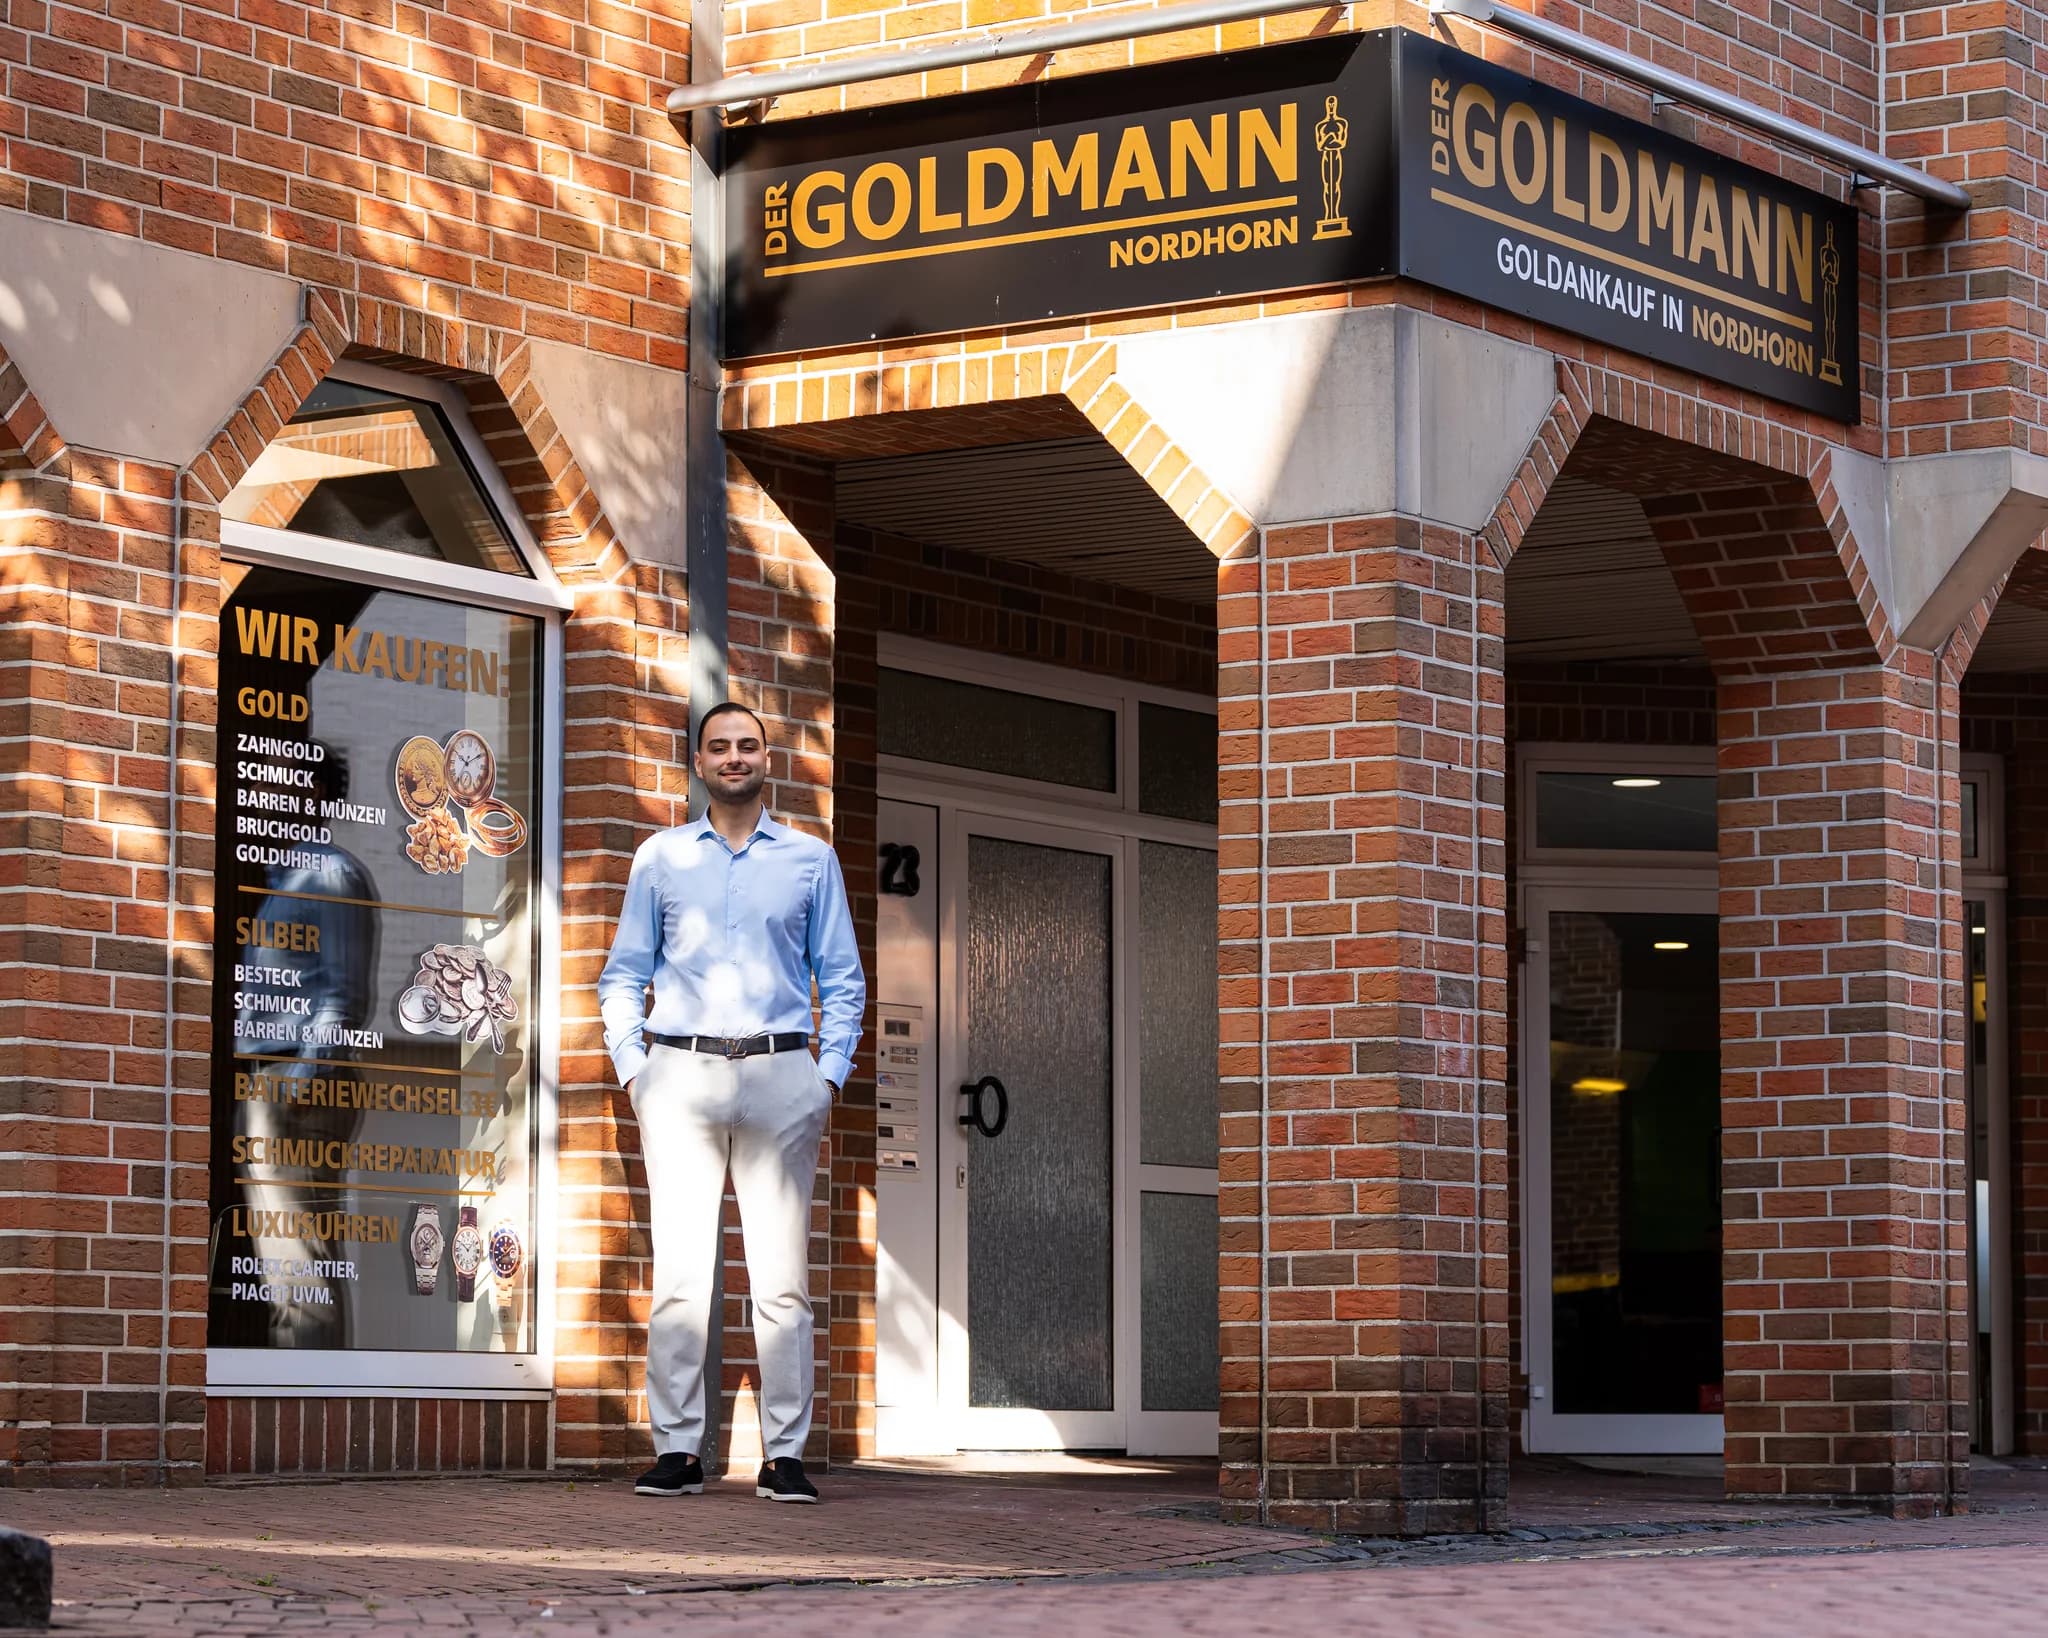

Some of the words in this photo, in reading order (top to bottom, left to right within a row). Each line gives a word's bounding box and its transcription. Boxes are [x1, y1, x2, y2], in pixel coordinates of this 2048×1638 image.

[1431, 77, 1450, 175] DER
[792, 102, 1298, 249] GOLDMANN
[1452, 82, 1813, 304] GOLDMANN
[764, 180, 788, 256] DER
[1110, 216, 1298, 268] NORDHORN
[1497, 237, 1656, 321] GOLDANKAUF
[1662, 294, 1683, 333] IN
[1692, 304, 1813, 376] NORDHORN
[235, 606, 319, 666] WIR
[334, 624, 511, 699] KAUFEN:
[237, 687, 309, 722] GOLD
[237, 733, 325, 762] ZAHNGOLD
[237, 761, 314, 789] SCHMUCK
[237, 789, 300, 815] BARREN
[305, 799, 316, 816] &
[320, 798, 386, 826] MÜNZEN
[237, 816, 332, 845] BRUCHGOLD
[236, 844, 332, 873] GOLDUHREN
[236, 917, 321, 953] SILBER
[234, 964, 302, 988] BESTECK
[234, 992, 311, 1016] SCHMUCK
[234, 1019, 297, 1042] BARREN
[302, 1026, 316, 1043] &
[317, 1024, 384, 1049] MÜNZEN
[234, 1072, 463, 1116] BATTERIEWECHSEL
[232, 1135, 497, 1178] SCHMUCKREPARATUR
[232, 1208, 399, 1243] LUXUSUHREN
[291, 1259, 359, 1281] CARTIER,
[231, 1282, 289, 1303] PIAGET
[293, 1286, 334, 1305] UVM.
